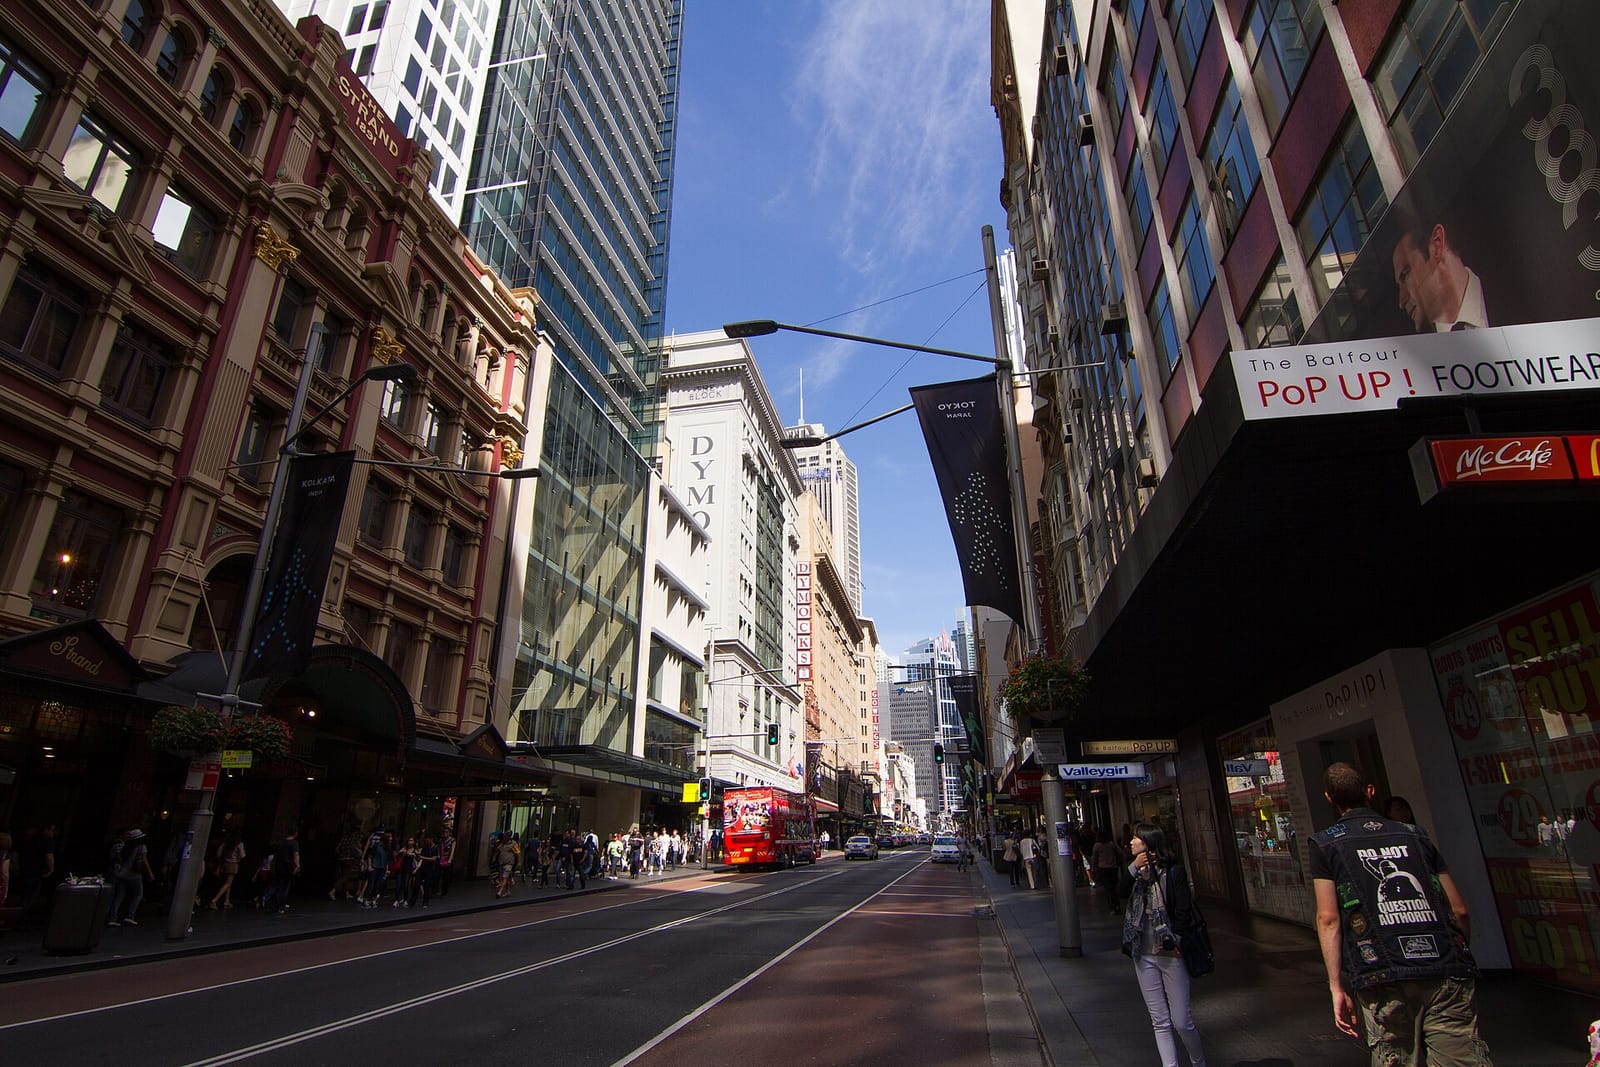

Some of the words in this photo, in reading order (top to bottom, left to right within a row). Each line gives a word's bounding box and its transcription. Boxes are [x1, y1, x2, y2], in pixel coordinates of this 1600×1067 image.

[338, 76, 399, 157] STRAND
[360, 88, 384, 124] THE
[355, 116, 378, 147] 1891
[1249, 357, 1292, 373] The
[1305, 347, 1400, 368] Balfour
[689, 391, 722, 401] BLOCK
[1455, 439, 1554, 478] McCafé
[301, 474, 336, 488] KOLKATA
[686, 435, 717, 566] DYMO
[797, 562, 810, 664] DYMOCKS
[1506, 602, 1593, 663] SELL
[49, 634, 104, 677] Strand
[872, 690, 880, 749] GOWINGS
[1062, 765, 1129, 778] Valleygirl
[1380, 845, 1409, 860] NOT
[1377, 898, 1430, 914] QUESTION
[1378, 910, 1439, 926] AUTHORITY
